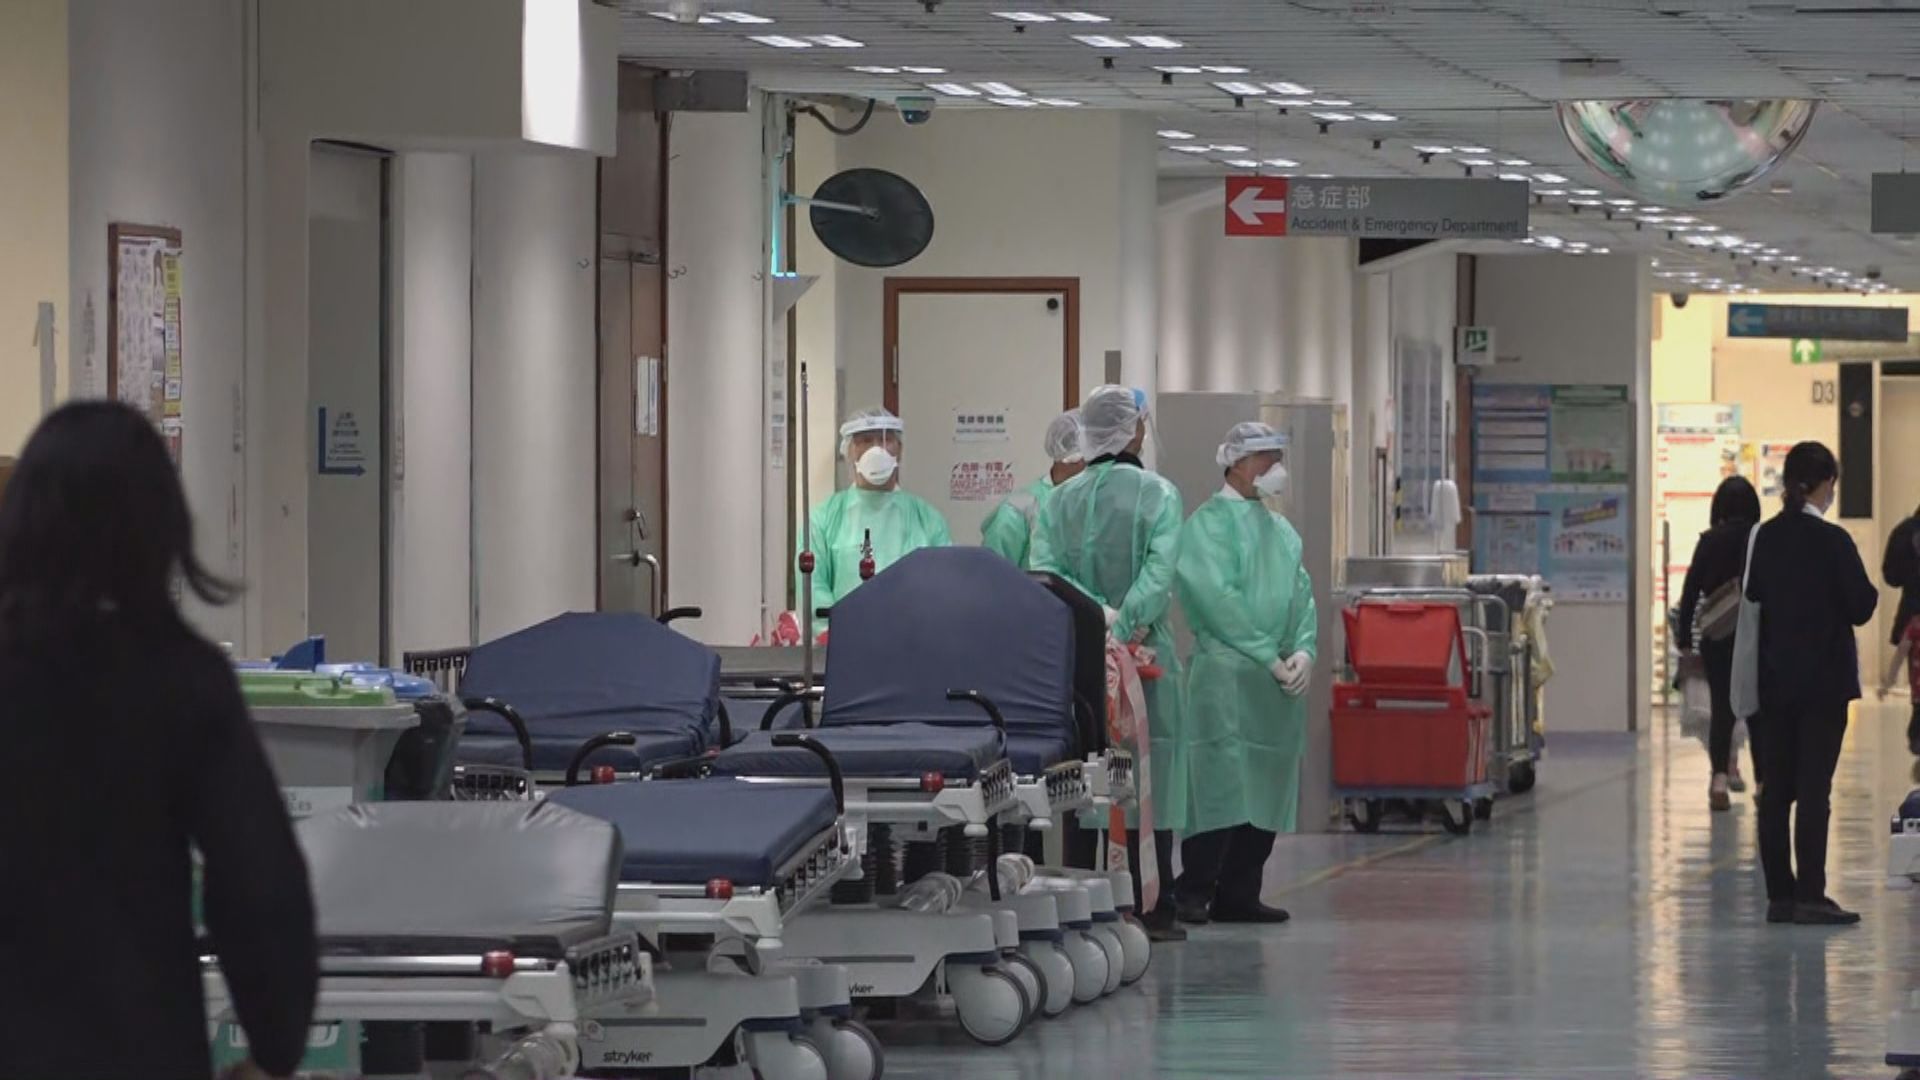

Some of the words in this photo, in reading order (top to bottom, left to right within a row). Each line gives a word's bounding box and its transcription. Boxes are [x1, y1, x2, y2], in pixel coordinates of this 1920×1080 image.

[1291, 185, 1371, 210] 急症部
[1291, 217, 1348, 231] Accident
[1352, 218, 1359, 231] &
[1364, 218, 1439, 235] Emergency
[1442, 219, 1518, 235] Department
[1812, 380, 1834, 404] D3
[849, 982, 875, 995] yker
[603, 1049, 653, 1064] stryker
